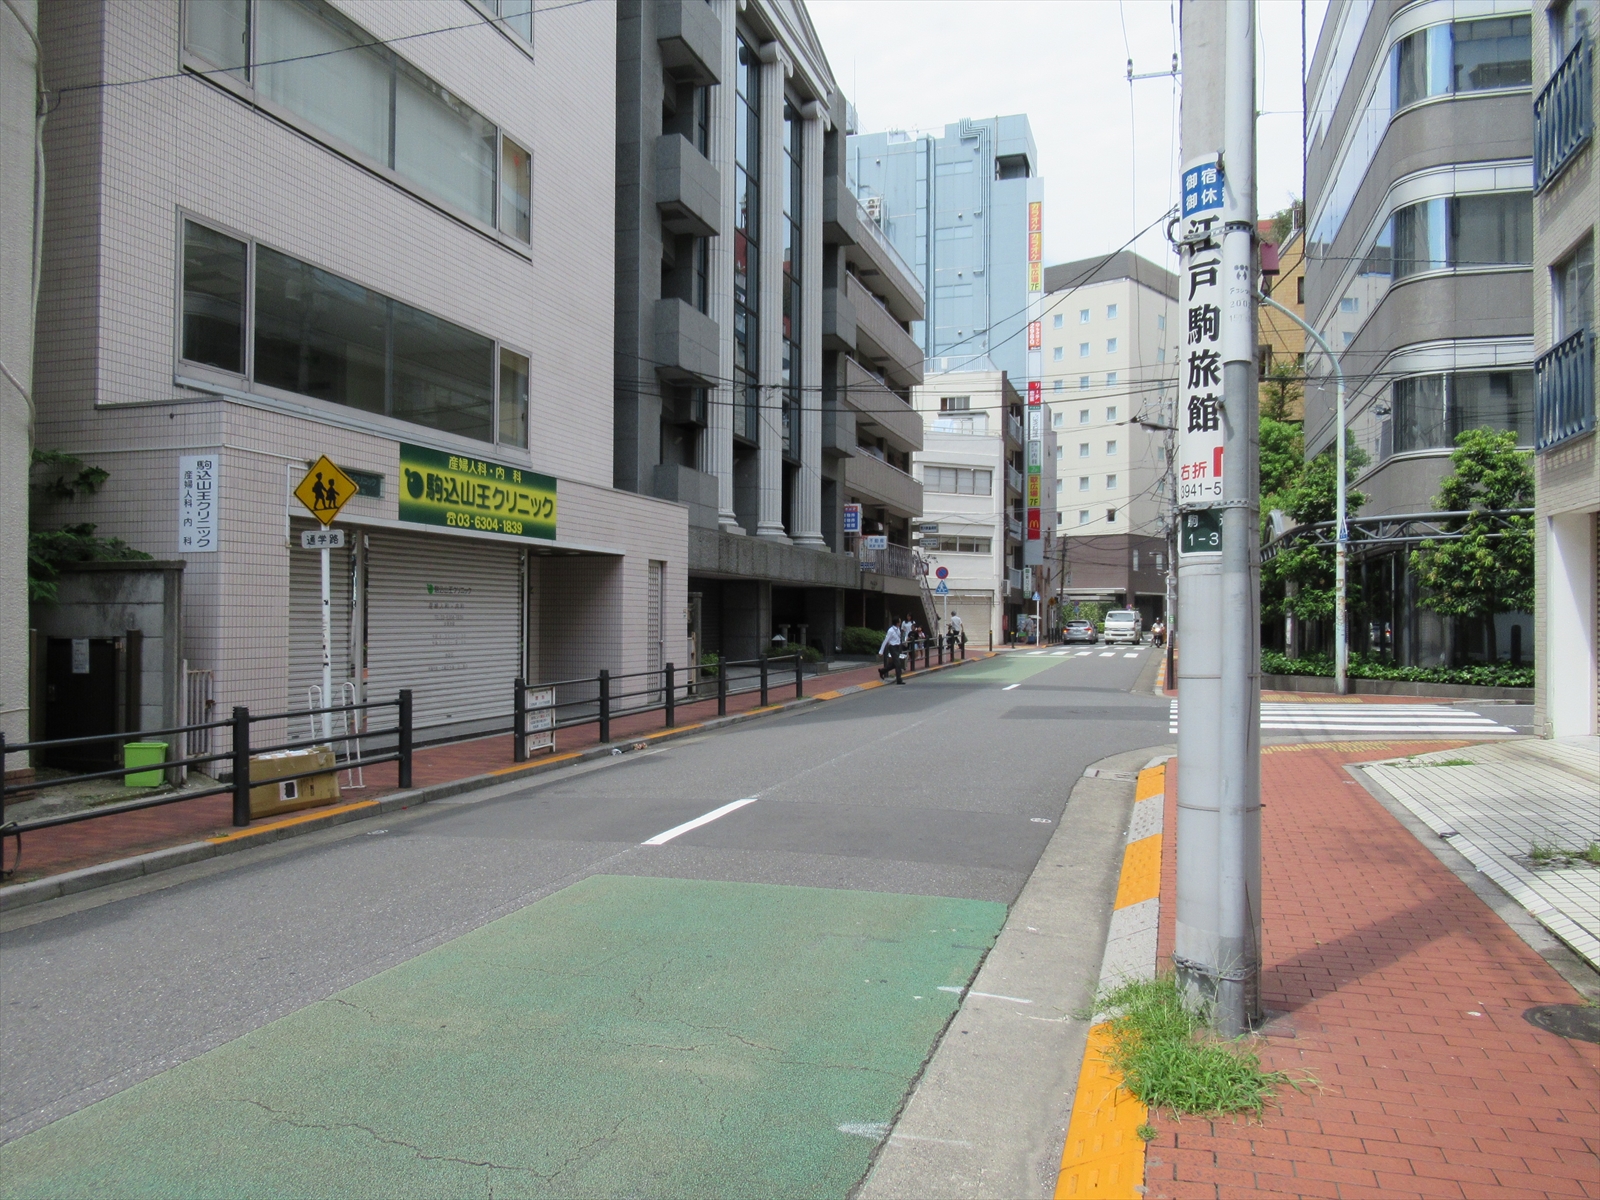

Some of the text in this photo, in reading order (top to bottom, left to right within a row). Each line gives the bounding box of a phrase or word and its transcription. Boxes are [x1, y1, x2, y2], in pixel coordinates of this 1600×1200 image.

[1185, 168, 1225, 191] 御宿
[1185, 187, 1225, 211] 御休
[1030, 203, 1039, 230] カラオケ
[1030, 233, 1039, 260] カラオケ
[1031, 283, 1039, 291] 7F
[1187, 214, 1222, 434] 江戸駒旅館
[448, 456, 522, 484] 産婦人科・内科
[1181, 461, 1207, 480] 右折
[425, 472, 554, 519] 駒込山王クリニック
[1030, 476, 1038, 497] 歌広場
[196, 460, 212, 547] 駒込山王クリニック
[1030, 498, 1039, 506] 7F
[457, 513, 523, 534] 03-6304-1839
[1187, 513, 1223, 528] 駒
[306, 534, 339, 545] 通学路
[1188, 532, 1219, 546] 1-3
